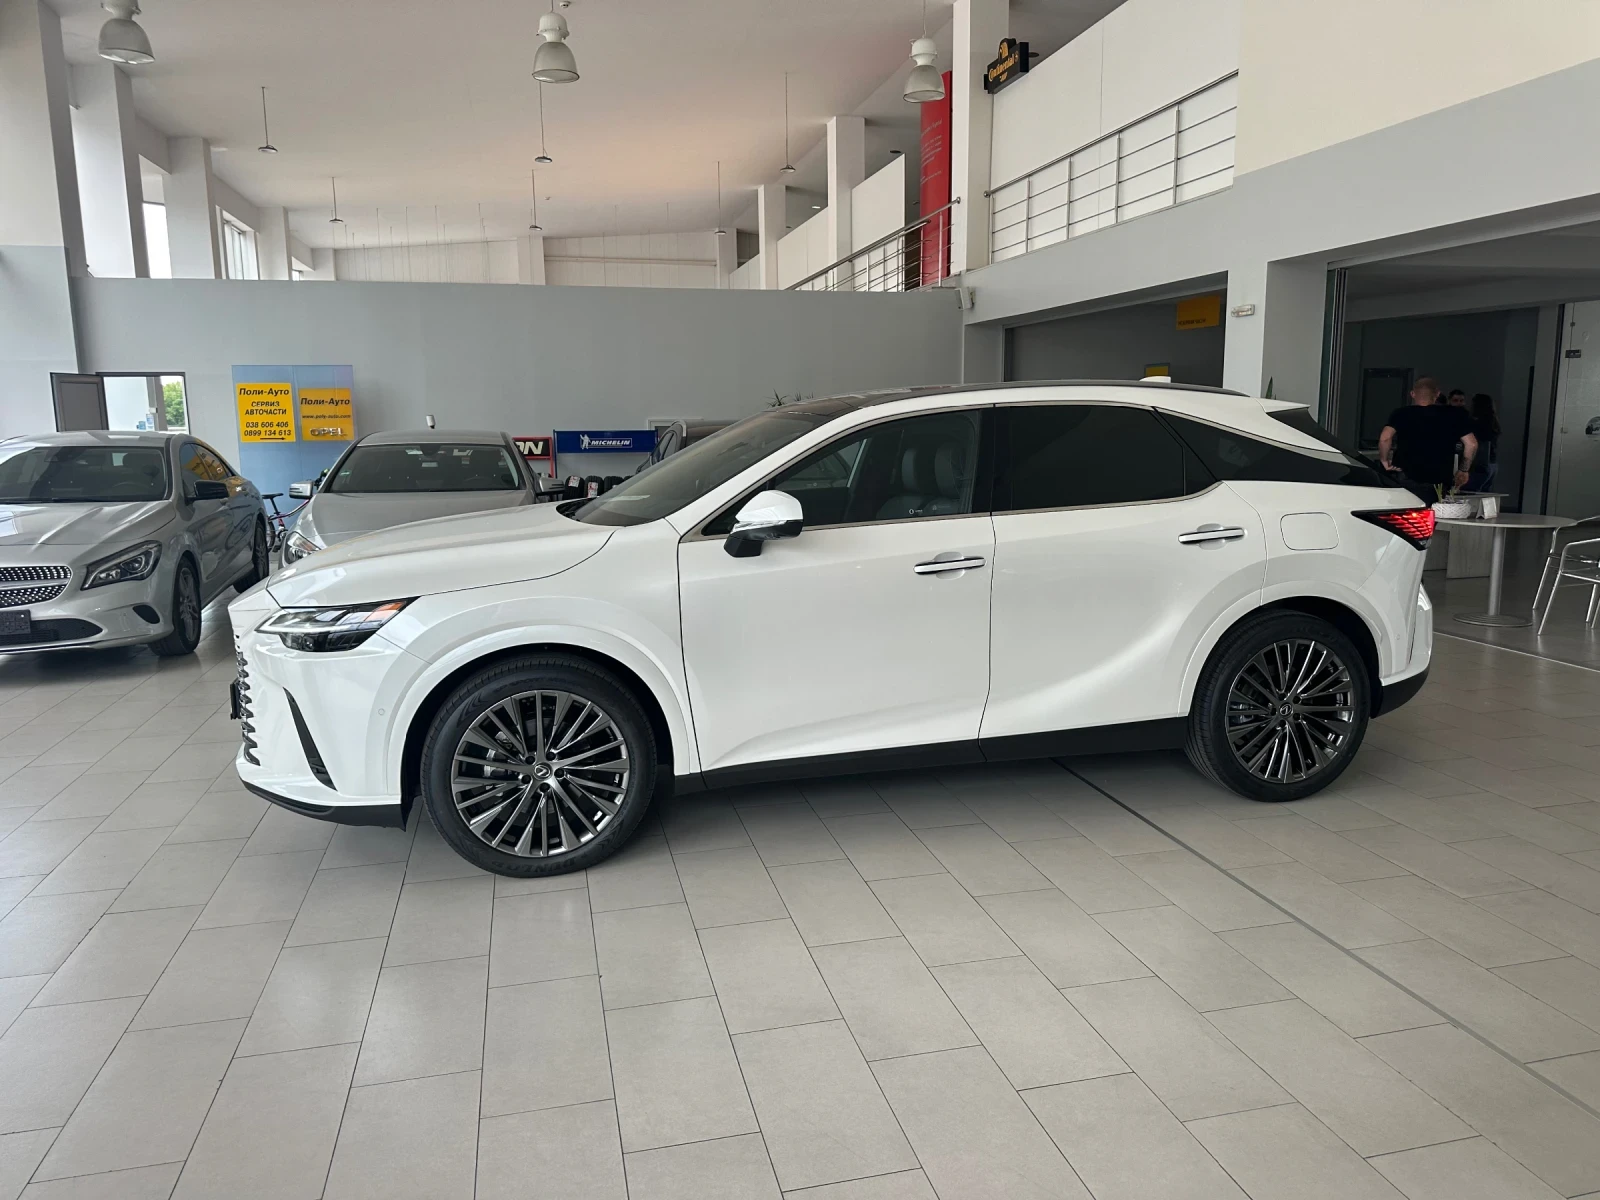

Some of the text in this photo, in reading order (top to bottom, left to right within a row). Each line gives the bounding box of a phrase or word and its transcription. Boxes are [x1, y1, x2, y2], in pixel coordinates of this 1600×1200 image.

[239, 388, 290, 397] Поли-Ауто
[300, 397, 350, 406] Поли-Ауто
[310, 427, 347, 436] OPEL
